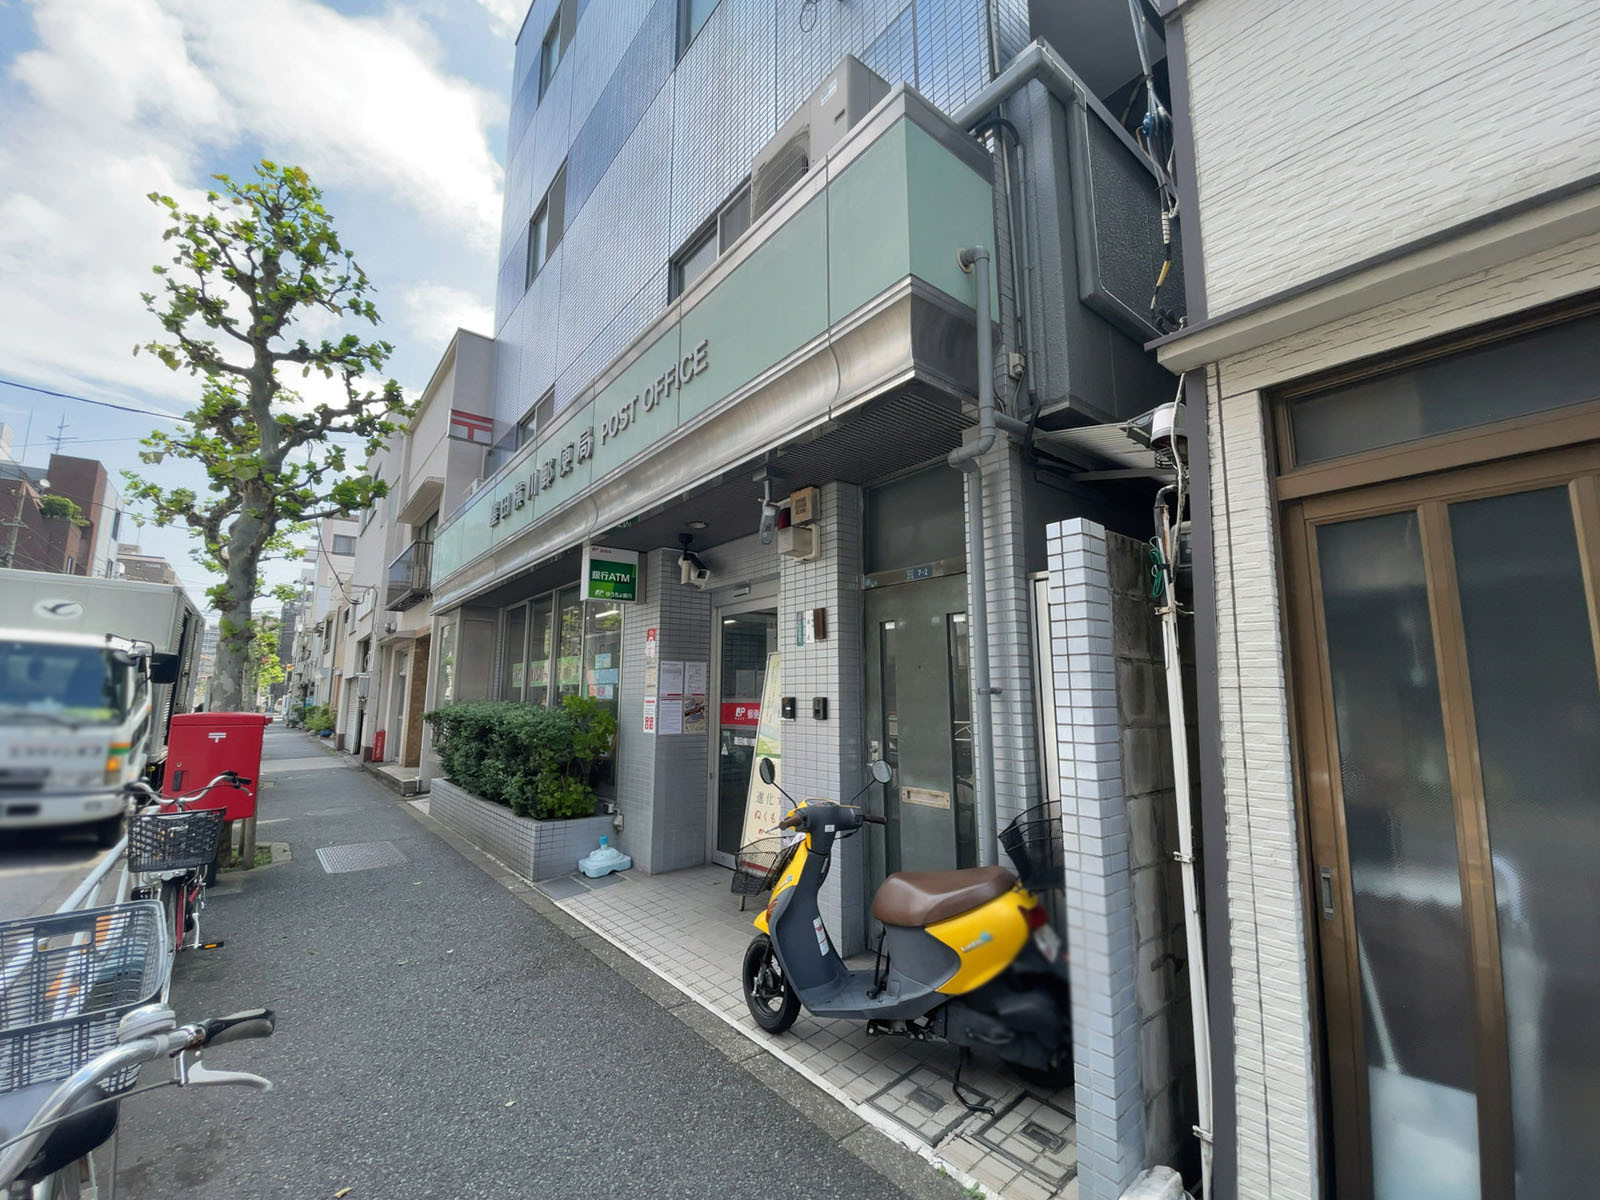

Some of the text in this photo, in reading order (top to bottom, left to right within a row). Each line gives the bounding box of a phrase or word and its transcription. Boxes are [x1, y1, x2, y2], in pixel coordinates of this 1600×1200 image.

[601, 394, 640, 446] POST
[643, 339, 709, 413] OFFICE
[592, 571, 630, 583] 銀行ATM
